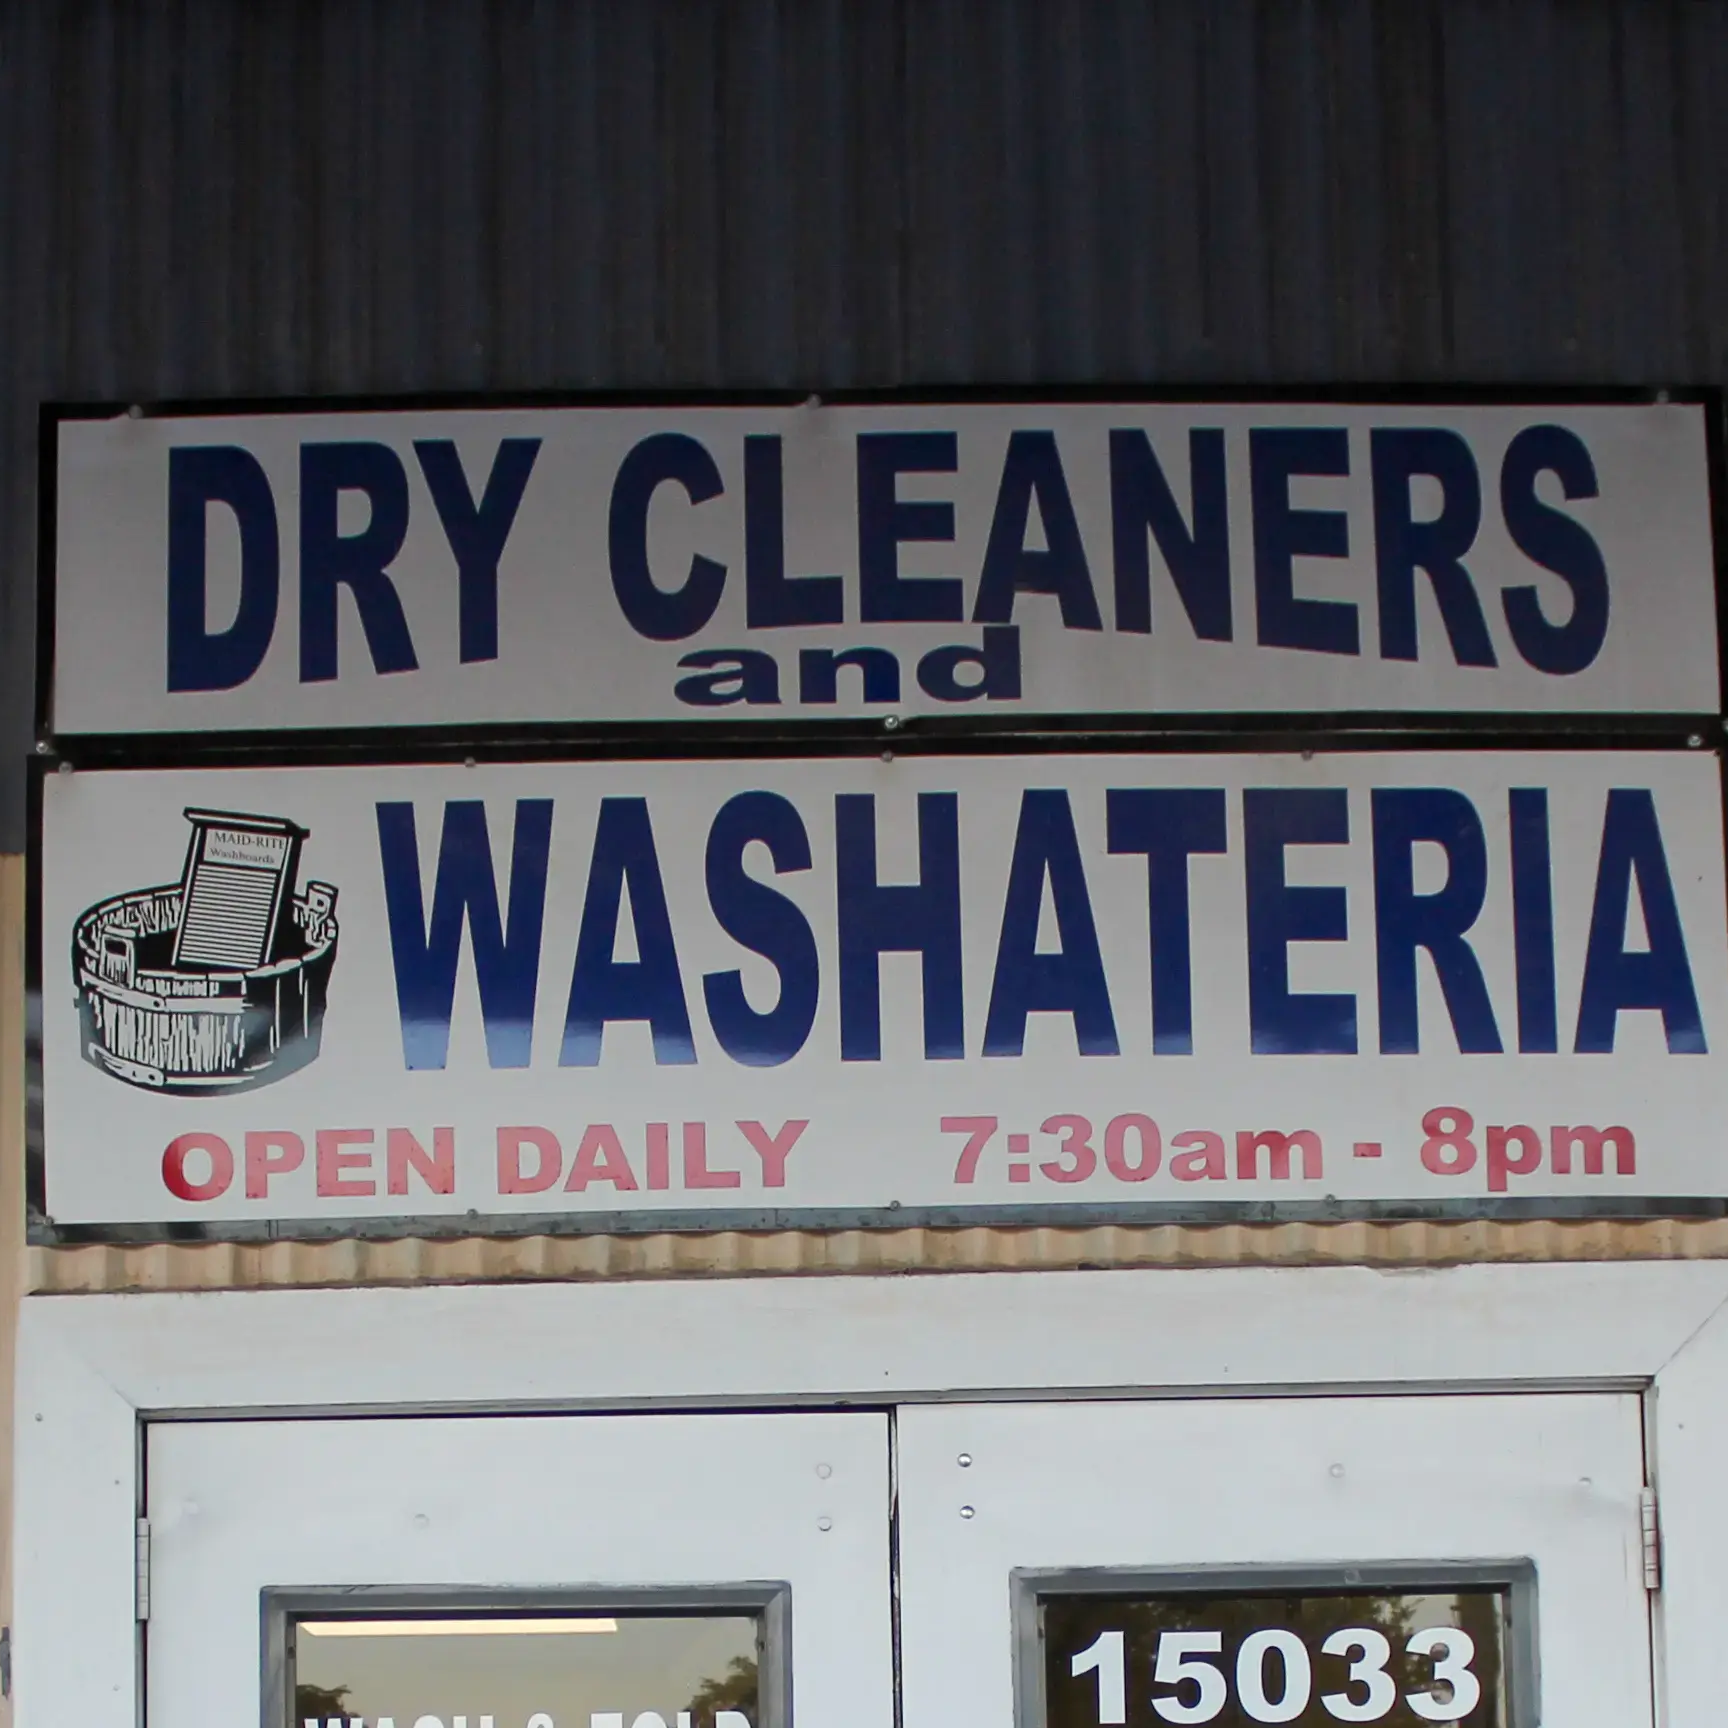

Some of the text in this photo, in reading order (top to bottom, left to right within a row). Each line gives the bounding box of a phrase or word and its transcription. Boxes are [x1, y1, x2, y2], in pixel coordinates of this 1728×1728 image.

[168, 425, 1609, 692] DRY CLEANERS
[675, 625, 1021, 706] and
[210, 848, 275, 864] Washboards
[376, 788, 1707, 1069] WASHATERIA
[161, 1127, 454, 1201] OPEN
[497, 1120, 809, 1194] DAILY
[941, 1113, 1322, 1183] 7:30am
[1421, 1107, 1636, 1192] 8pm
[1071, 1627, 1481, 1725] 15033
